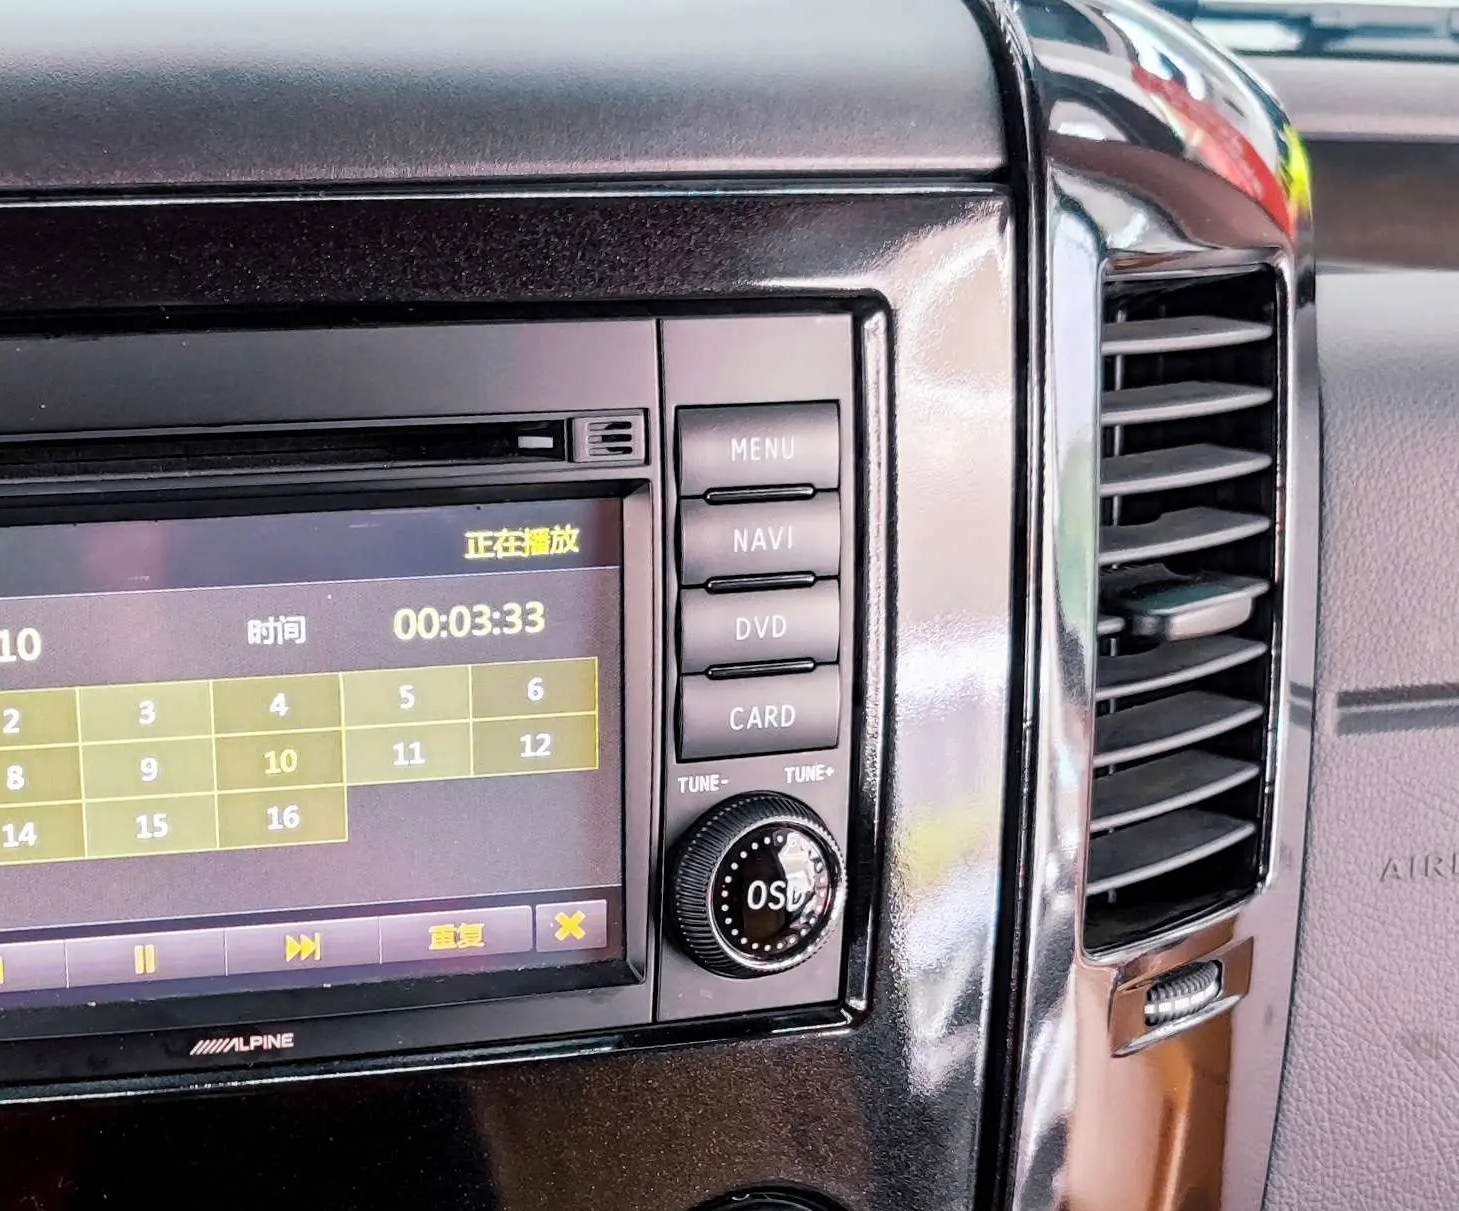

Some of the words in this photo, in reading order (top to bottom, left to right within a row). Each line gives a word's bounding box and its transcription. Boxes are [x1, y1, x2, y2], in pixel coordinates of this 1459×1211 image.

[731, 435, 796, 461] MENU
[464, 523, 580, 559] 正在播放
[733, 526, 794, 552] NAVI
[247, 615, 306, 645] 时间
[393, 602, 545, 641] 00:03:33
[735, 614, 787, 641] DVD
[3, 709, 20, 734] 2
[139, 701, 156, 726] 3
[270, 692, 288, 717] 4
[399, 685, 415, 709] 5
[527, 678, 543, 702] 6
[730, 704, 796, 729] CARD
[6, 766, 24, 790] 8
[140, 758, 158, 782] 9
[264, 749, 297, 774] 10
[392, 741, 426, 766] 11
[520, 734, 552, 758] 12
[784, 764, 835, 784] TUNE+
[677, 774, 729, 793] TUNE-
[1, 823, 38, 848] 14
[136, 814, 168, 839] 15
[266, 806, 300, 831] 16
[747, 880, 805, 912] OSD
[429, 922, 484, 950] 重复
